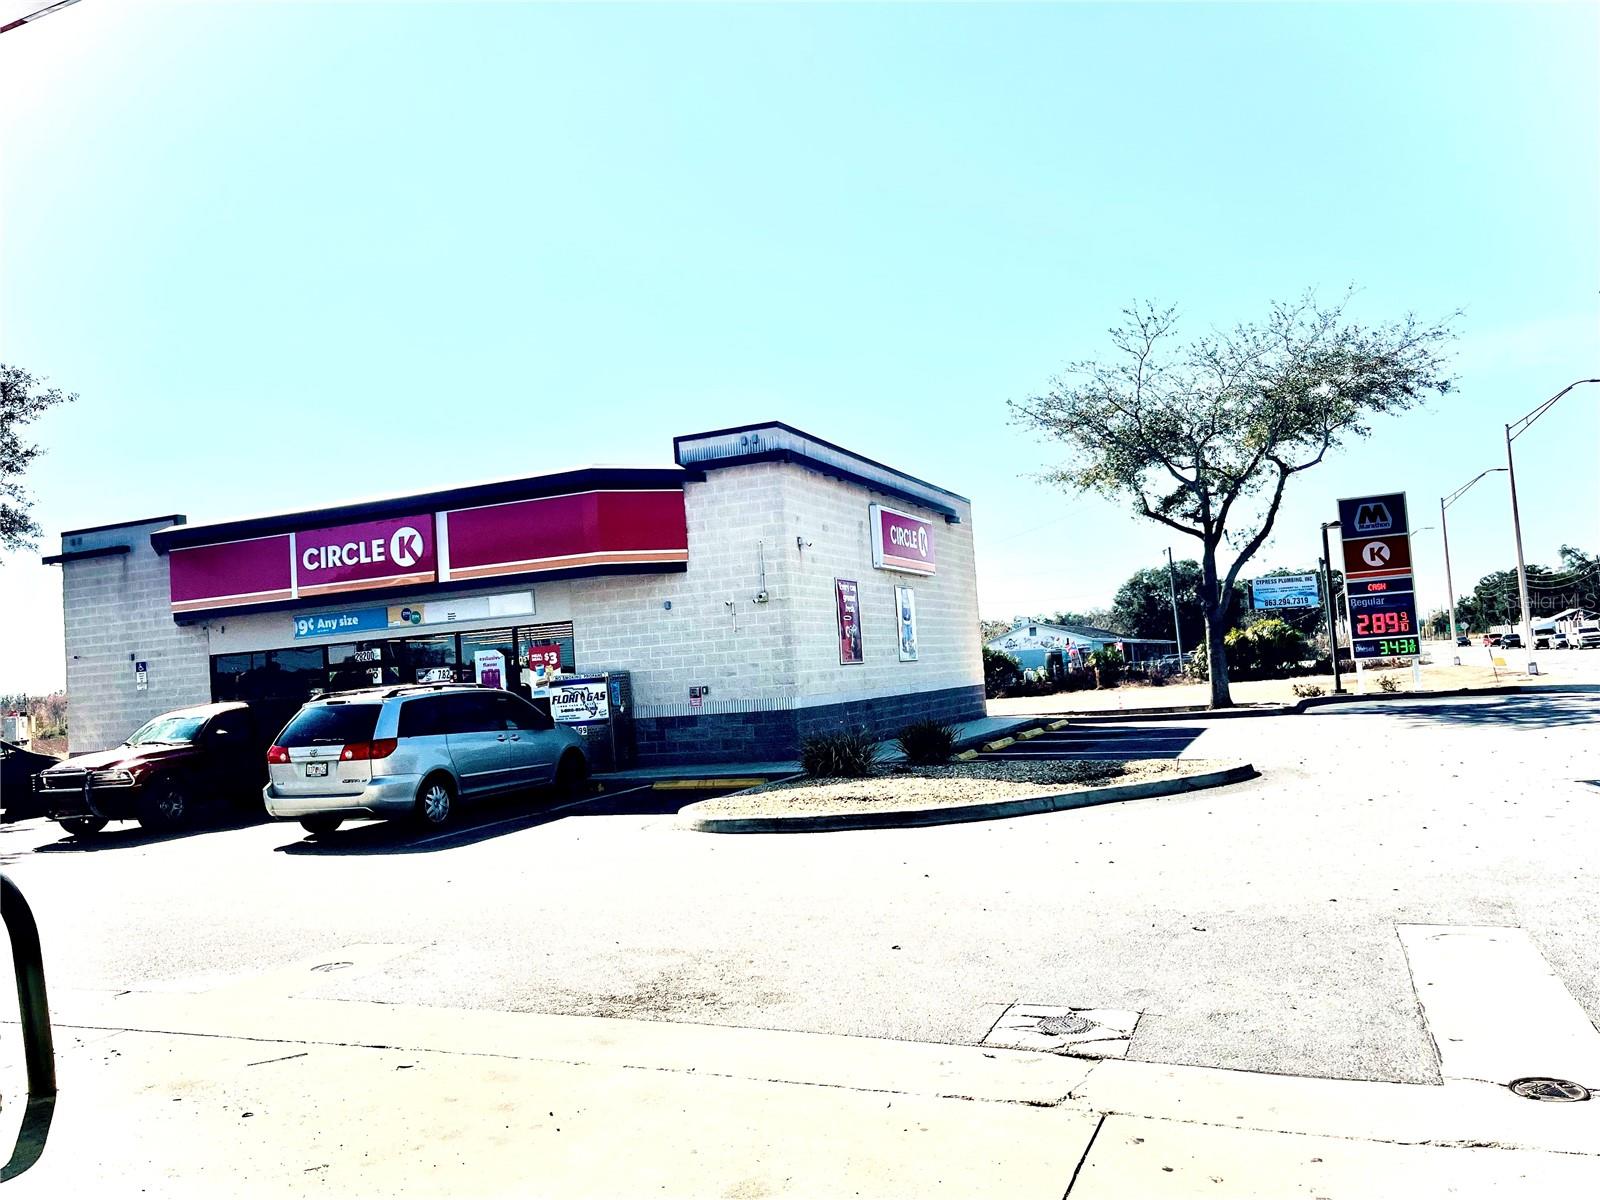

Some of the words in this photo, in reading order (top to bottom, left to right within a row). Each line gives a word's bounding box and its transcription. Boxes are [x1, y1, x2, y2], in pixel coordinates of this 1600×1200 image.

[1358, 522, 1391, 531] Marathon
[890, 525, 917, 549] CIRCLE
[918, 527, 928, 557] K
[302, 538, 386, 571] CIRCLE
[394, 530, 423, 565] K
[1366, 544, 1390, 565] K
[1256, 578, 1277, 586] CYPRESS
[1367, 583, 1386, 591] CASH
[1264, 597, 1309, 607] 863.294.7319
[1350, 598, 1385, 608] Regular
[317, 618, 338, 630] Any
[339, 615, 359, 627] size
[1356, 612, 1399, 635] 2.89
[1379, 639, 1409, 655] 3.43
[544, 652, 558, 665] $3
[587, 691, 607, 702] GAS
